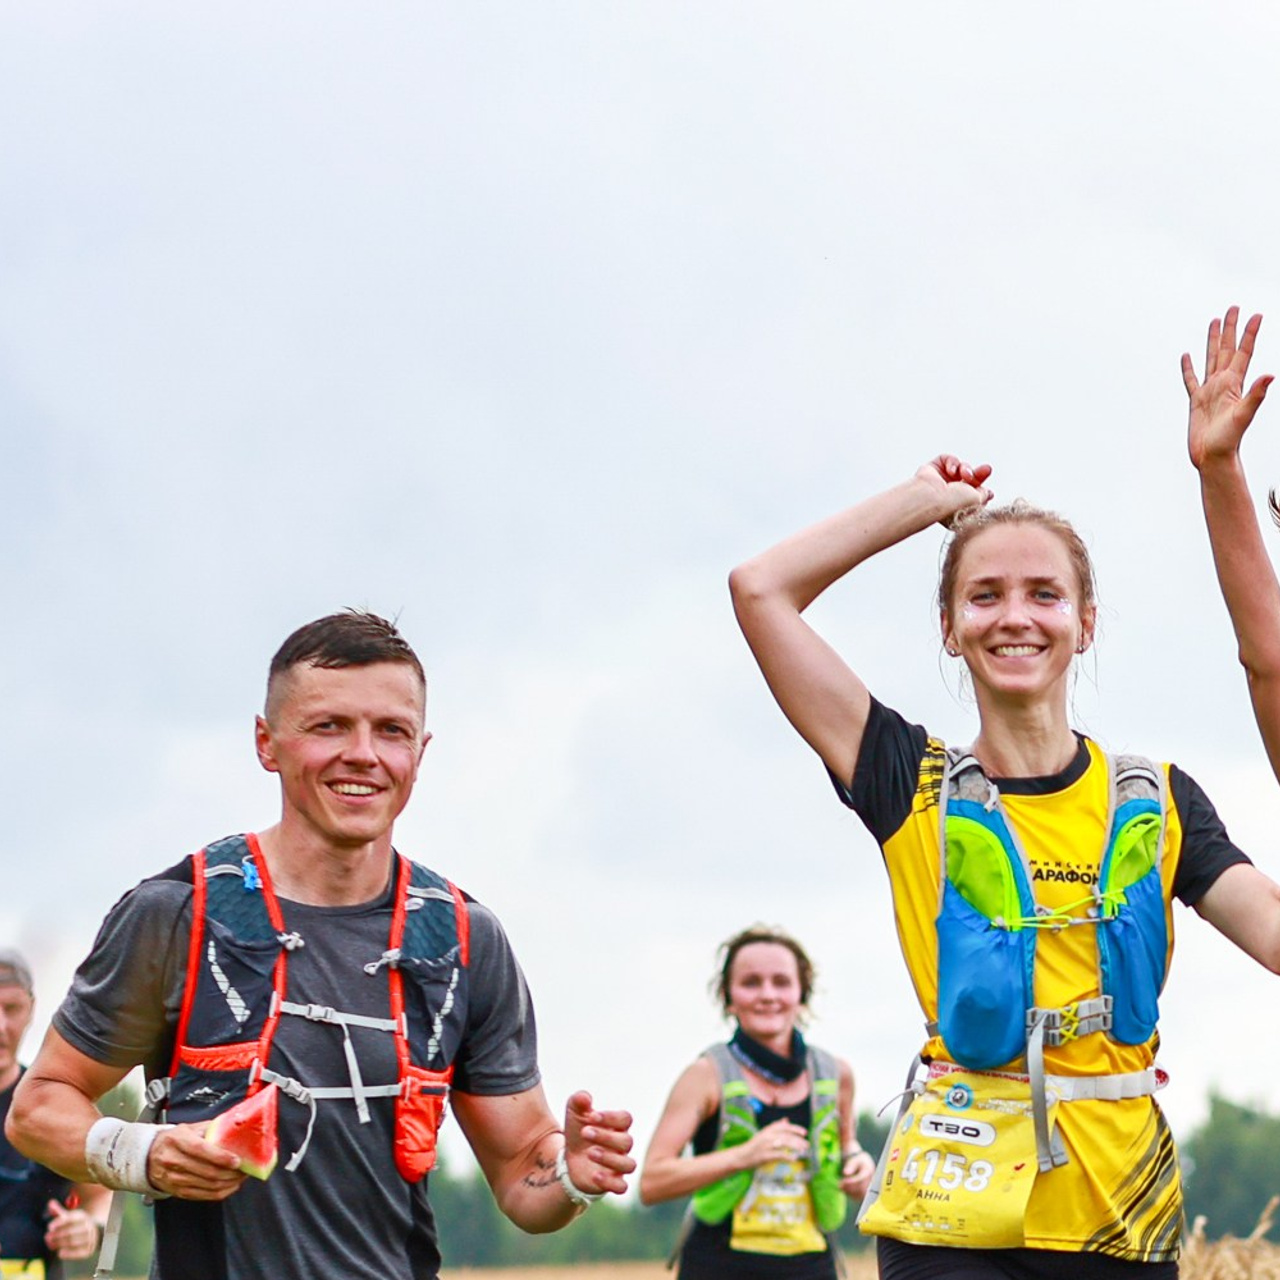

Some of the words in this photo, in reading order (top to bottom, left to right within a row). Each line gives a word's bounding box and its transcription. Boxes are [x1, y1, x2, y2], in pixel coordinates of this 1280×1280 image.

[1032, 868, 1099, 886] АРАФОН
[929, 1120, 981, 1138] T30
[901, 1146, 995, 1193] 4158
[916, 1188, 951, 1202] АННА
